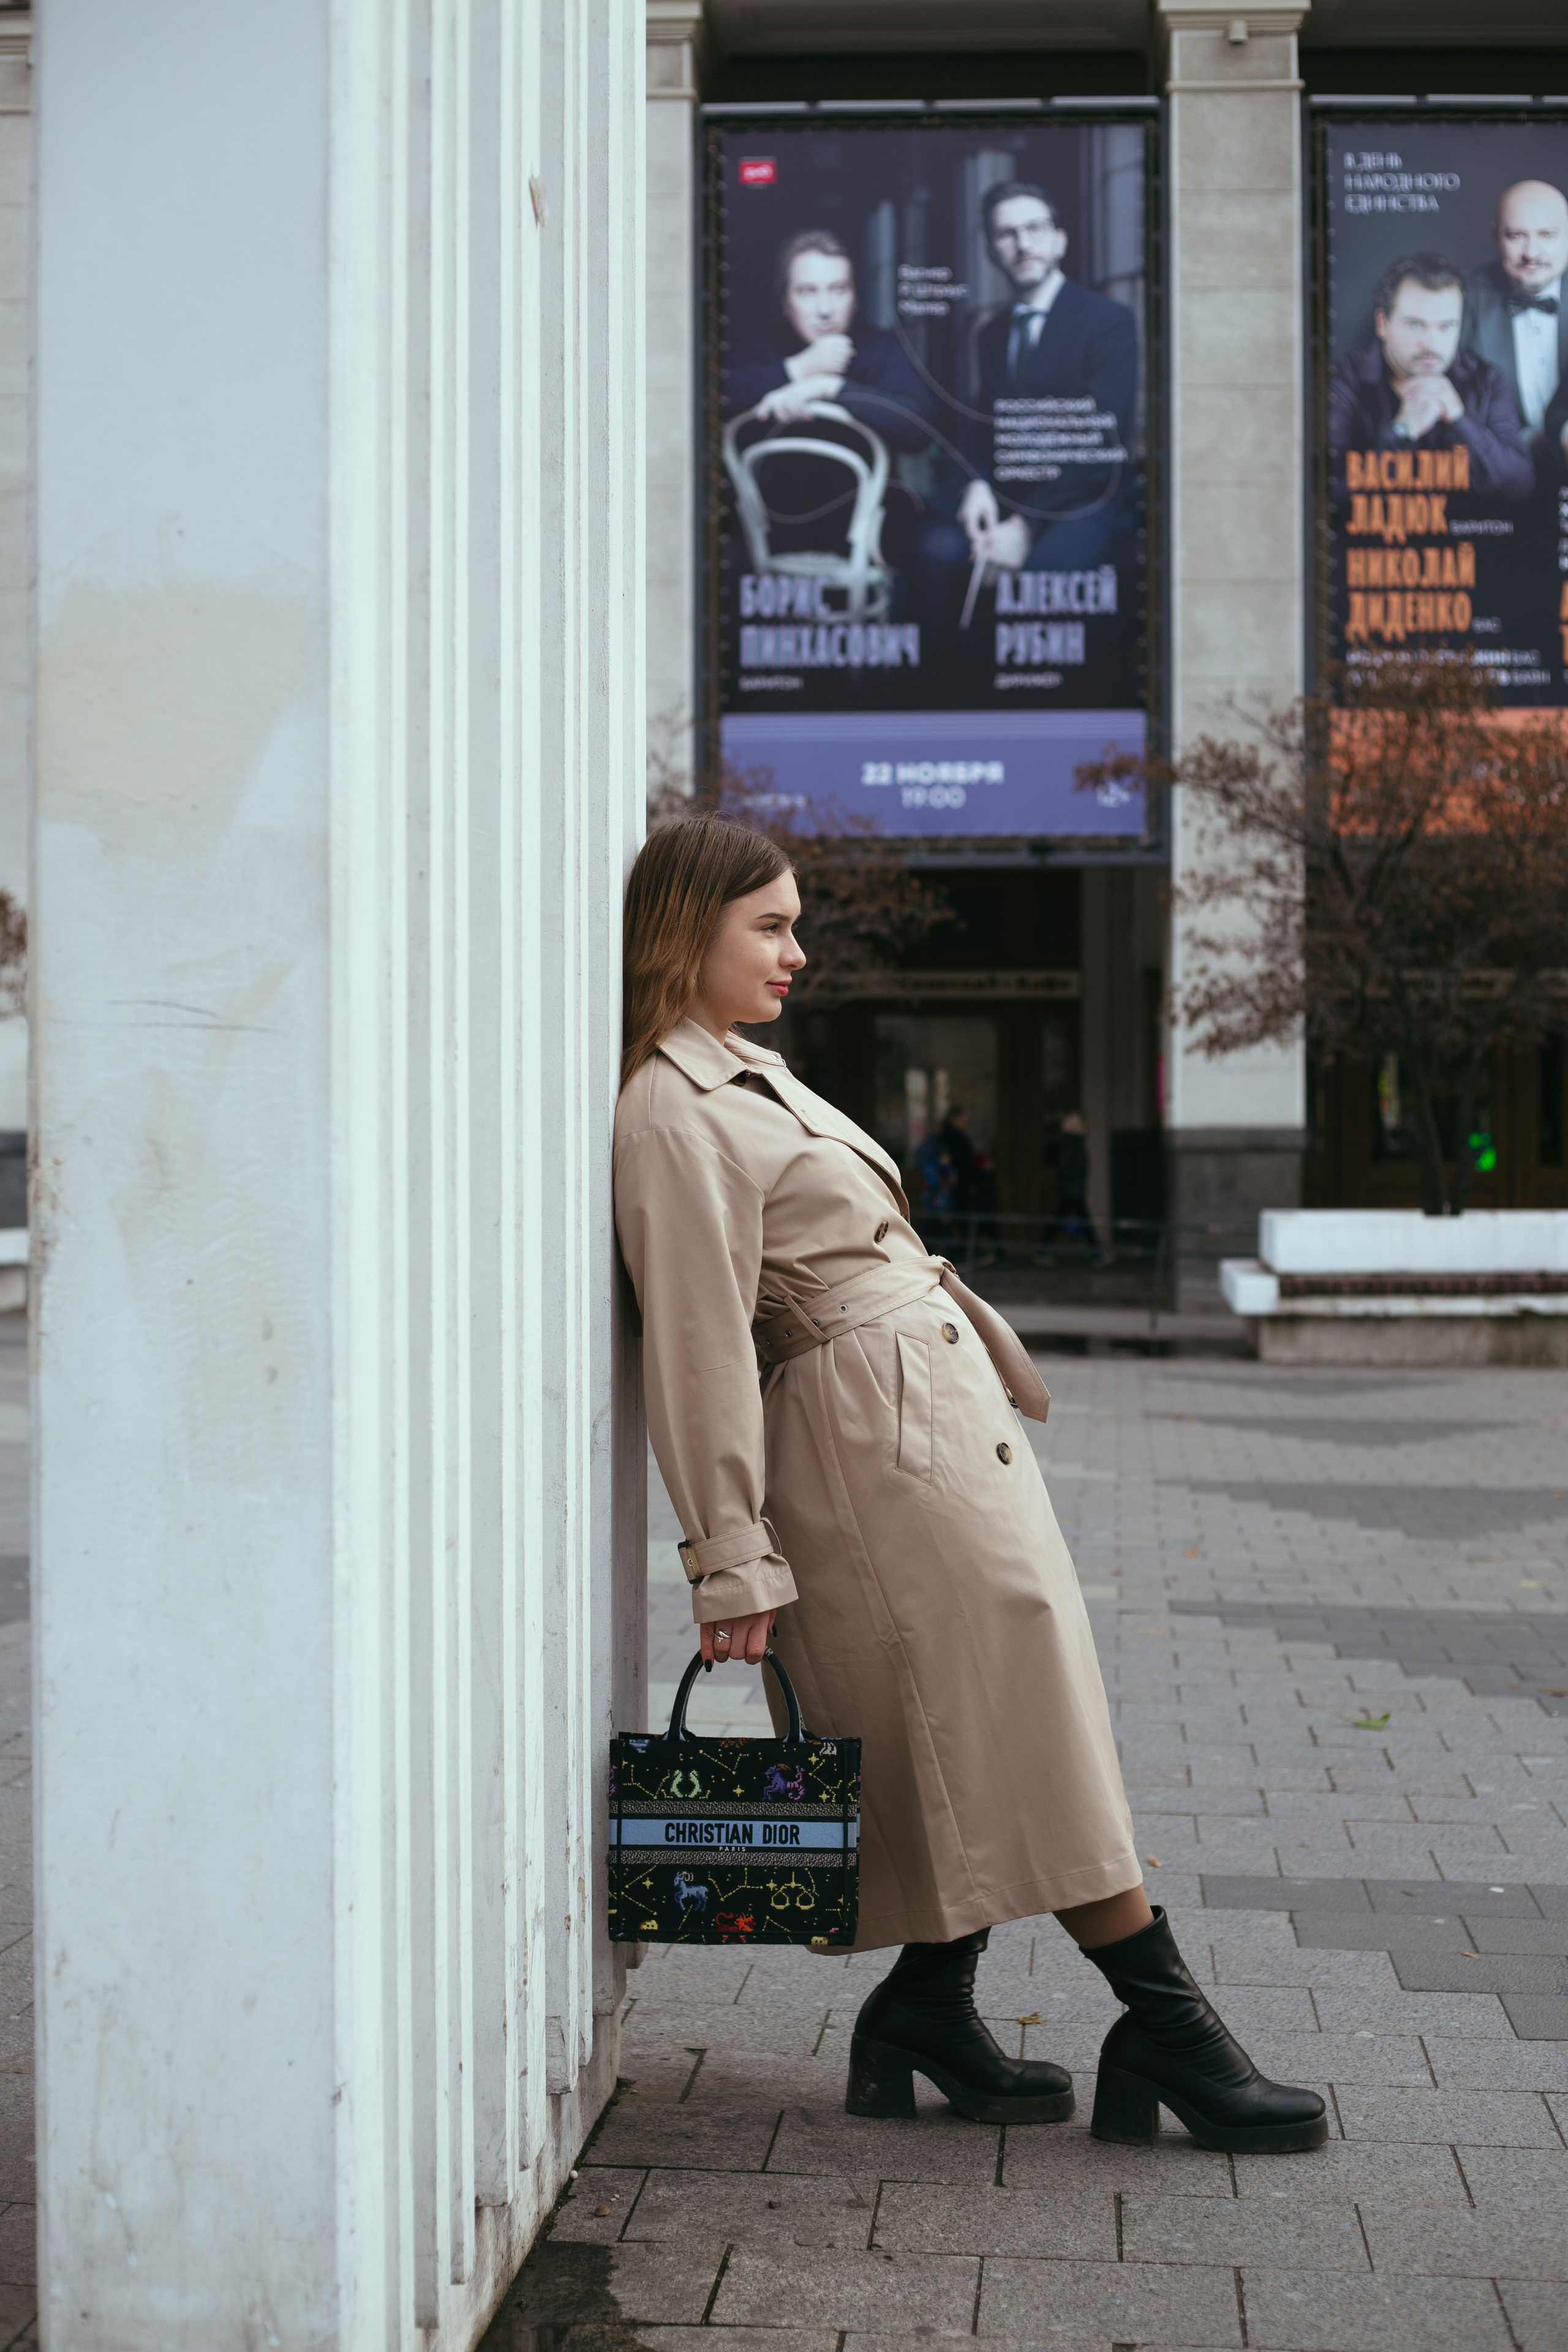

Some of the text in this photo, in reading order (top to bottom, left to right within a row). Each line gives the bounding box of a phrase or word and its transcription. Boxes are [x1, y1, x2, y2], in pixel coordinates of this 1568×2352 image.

[1344, 173, 1460, 193] НАРОДНОГО
[1355, 152, 1403, 173] ДЕНЬ
[1344, 194, 1439, 214] ЕДИНСТВА
[1346, 443, 1469, 491] ВАСИЛИЙ
[1345, 494, 1449, 544] ЛАДЮК
[1346, 541, 1475, 589] НИКОЛАЙ
[740, 575, 830, 618] БОРИС
[995, 564, 1117, 615] АЛЕКСЕЙ
[1346, 591, 1472, 642] ДИДЕНКО
[740, 624, 920, 668] ПИНХАСОВИЧ
[995, 622, 1085, 665] РУБИН
[861, 761, 1005, 785] 22 НОЯБРЯ
[665, 1822, 800, 1845] CHRISTIAN DIOR
